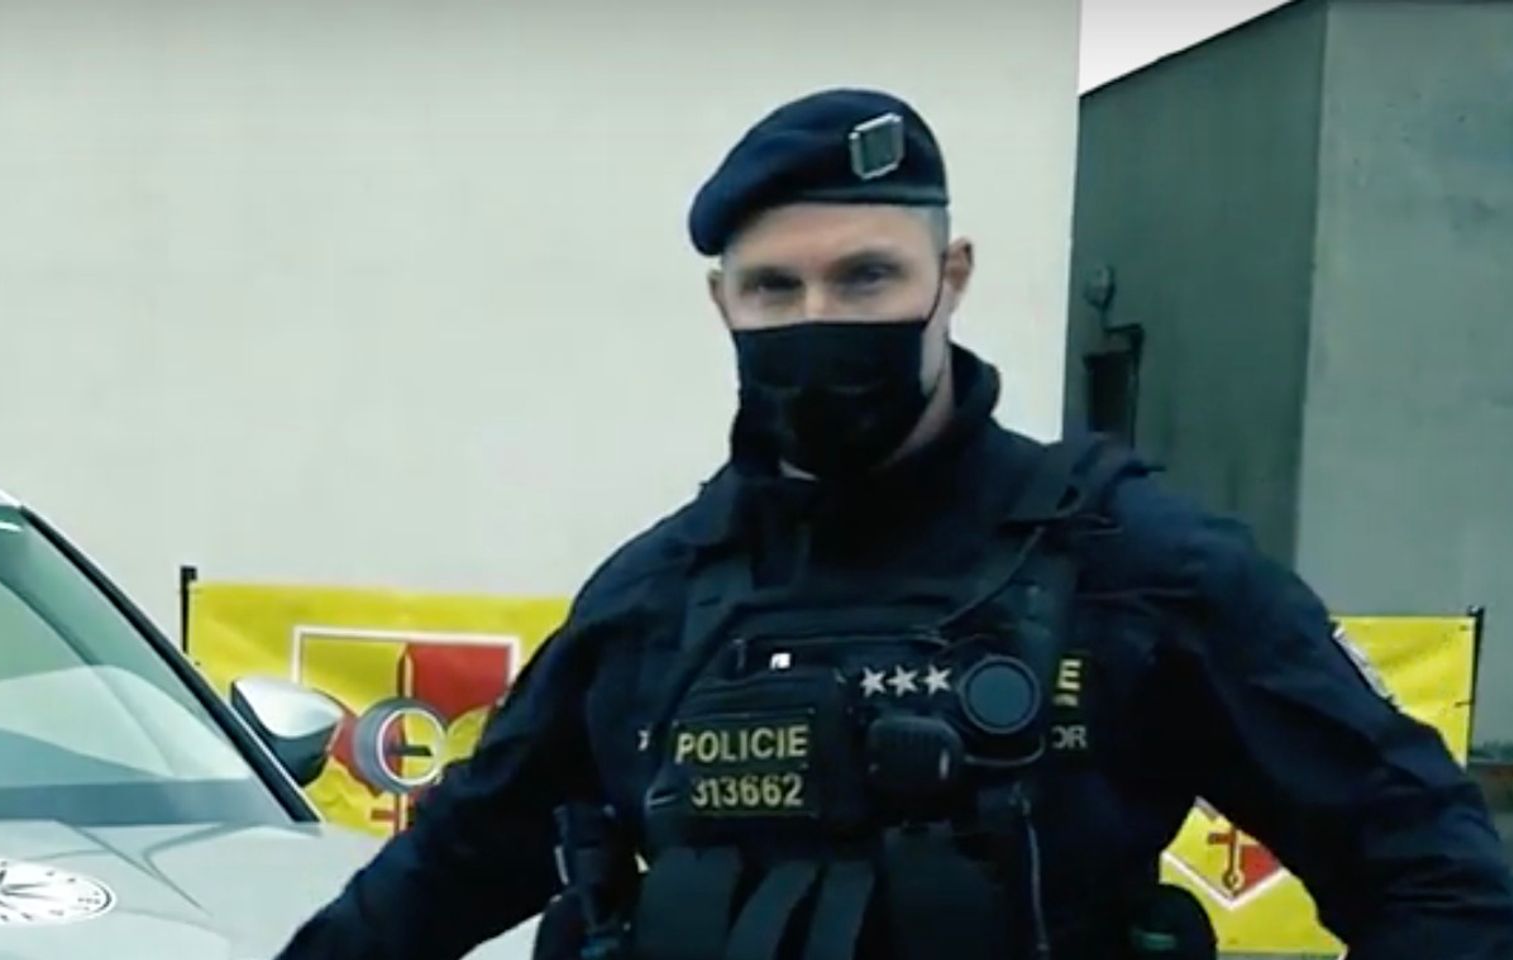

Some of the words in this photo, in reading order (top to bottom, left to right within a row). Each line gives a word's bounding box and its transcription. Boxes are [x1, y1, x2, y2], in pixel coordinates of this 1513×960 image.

[1055, 658, 1082, 692] E
[674, 724, 810, 765] POLICIE
[691, 772, 805, 808] 313662
